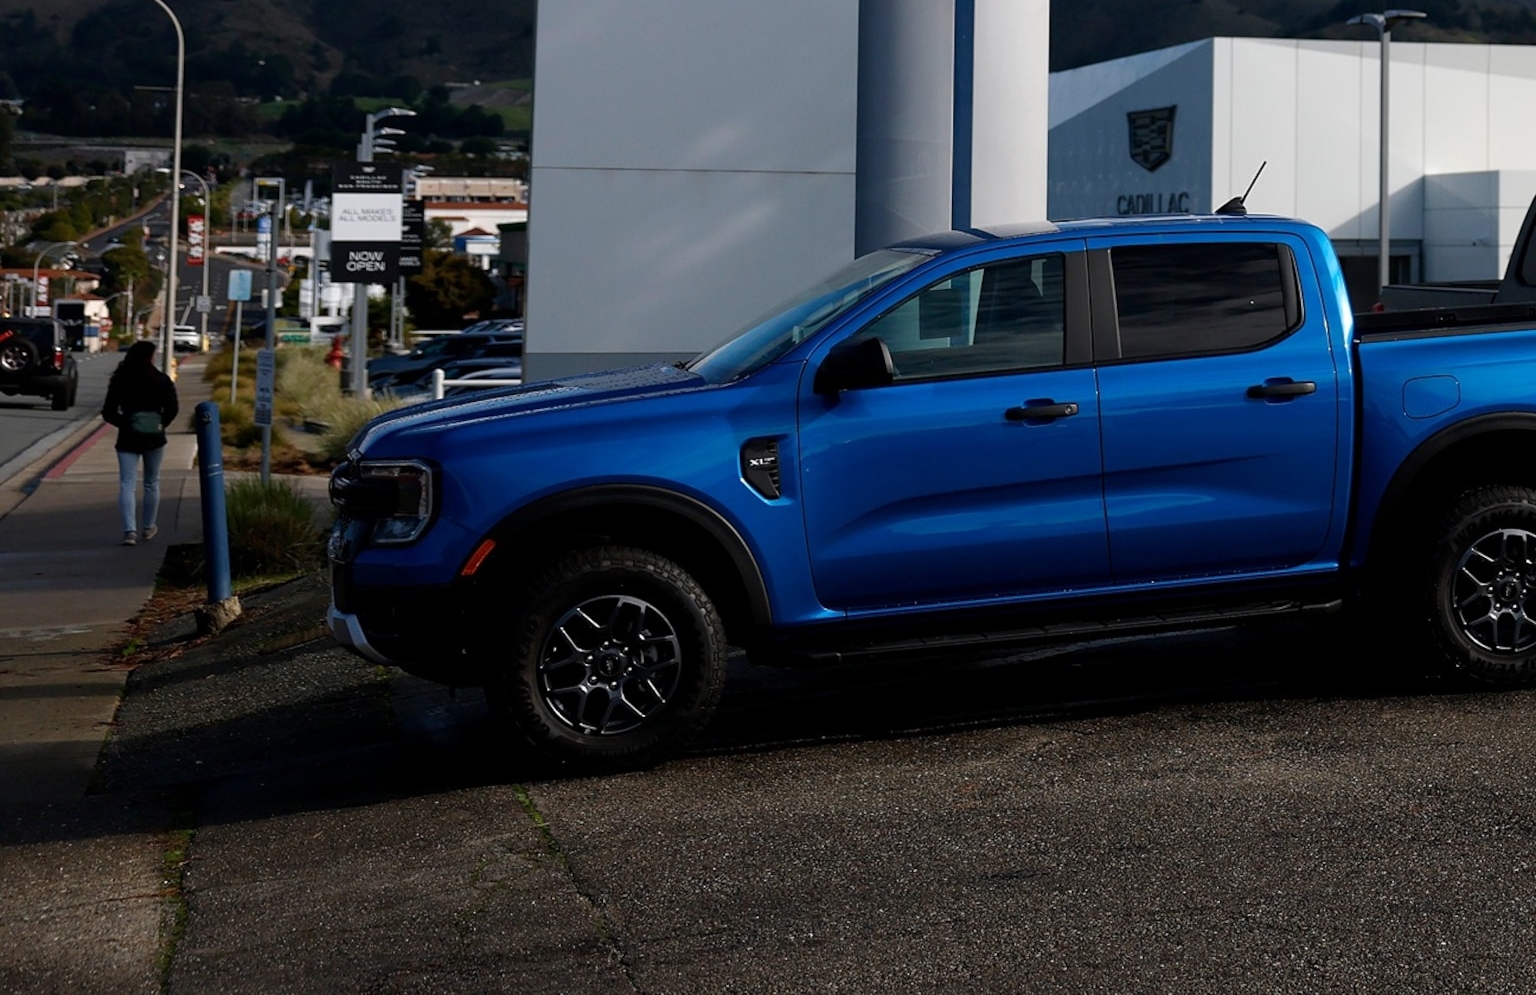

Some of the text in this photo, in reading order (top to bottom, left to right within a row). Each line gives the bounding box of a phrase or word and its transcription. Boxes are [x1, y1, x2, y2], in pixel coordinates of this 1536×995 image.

[1116, 191, 1190, 215] CADILLAC
[348, 251, 384, 261] NOW
[346, 261, 386, 271] OPEN
